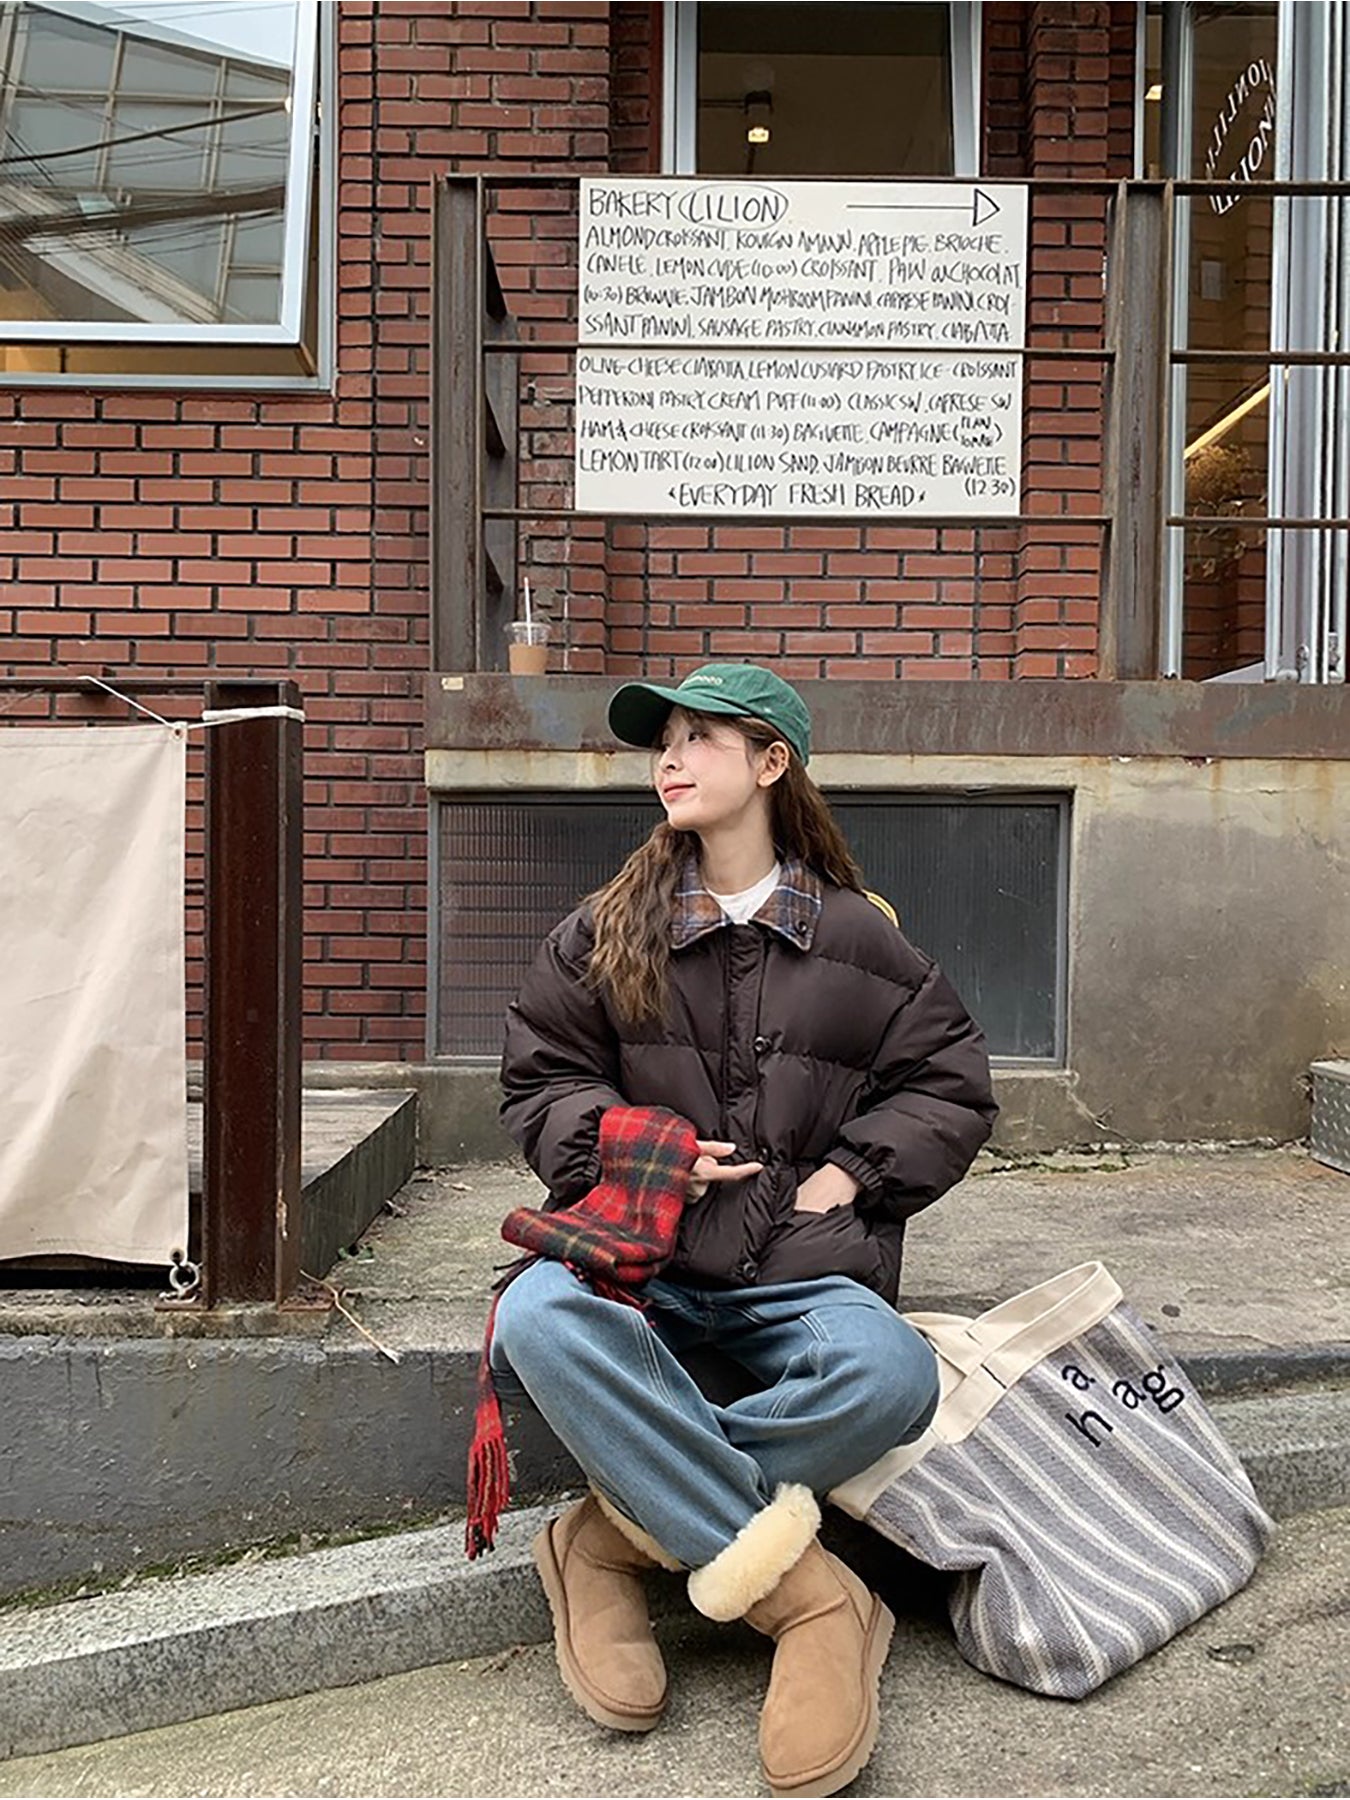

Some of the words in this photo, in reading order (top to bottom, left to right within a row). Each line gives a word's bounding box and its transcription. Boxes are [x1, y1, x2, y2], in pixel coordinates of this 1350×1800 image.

[589, 188, 678, 220] BAKERY
[689, 192, 779, 223] LILION
[585, 225, 656, 250] ALMOND
[655, 257, 704, 280] LEMON
[690, 284, 757, 309] JAMBON
[585, 311, 643, 337] SSANT
[698, 317, 761, 339] SAUSAGE
[748, 359, 800, 379] LEMON
[707, 389, 761, 411] CREAM
[766, 390, 799, 411] PUFF
[629, 421, 680, 440] CHEESE
[579, 448, 639, 473] LEMON
[639, 449, 683, 471] TART
[725, 453, 775, 473] LILION
[679, 483, 778, 508] EVERYDAY
[789, 483, 845, 507] FRESH
[855, 484, 915, 509] BREAD
